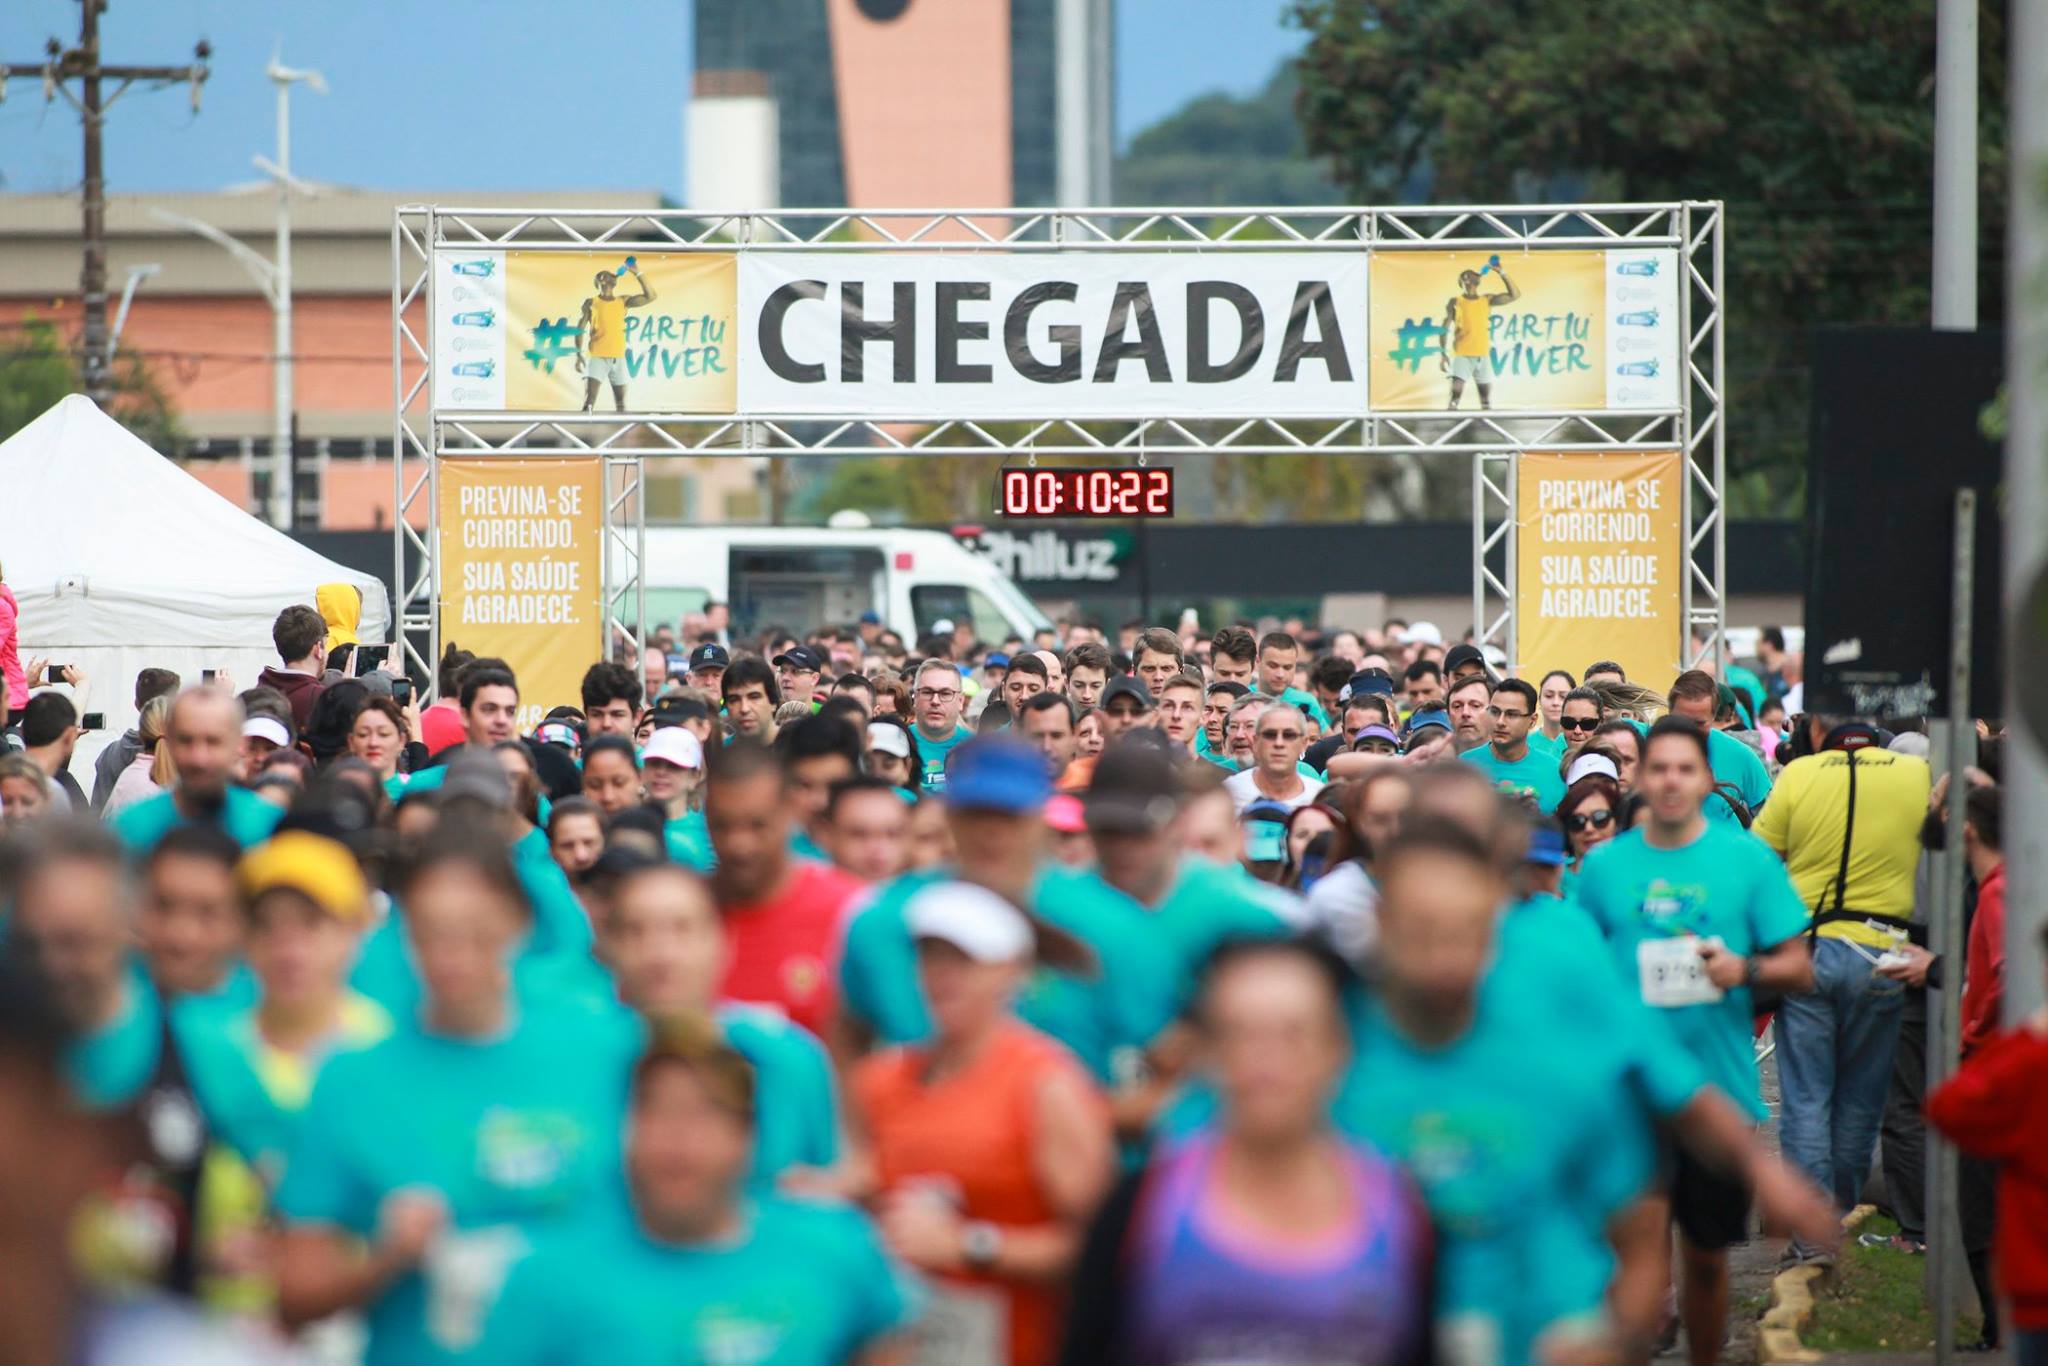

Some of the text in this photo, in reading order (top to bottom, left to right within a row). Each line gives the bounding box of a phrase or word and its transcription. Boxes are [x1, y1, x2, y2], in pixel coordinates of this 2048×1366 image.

[624, 315, 726, 345] PARTIU
[758, 279, 1353, 384] CHEGADA
[1488, 312, 1592, 343] PARTIU
[625, 345, 728, 379] VIVER
[1489, 343, 1592, 377] VIVER
[460, 485, 582, 516] PREVINA-SE
[1005, 472, 1169, 514] 00:10:22
[1538, 480, 1661, 510] PREVINA-SE
[463, 519, 578, 549] CORRENDO.
[1541, 512, 1657, 543] CORRENDO.
[463, 555, 580, 591] SUA SAÚDE
[1540, 549, 1658, 585] SUA SAÚDE
[462, 594, 580, 624] AGRADECE.
[1539, 588, 1658, 618] AGRADECE.
